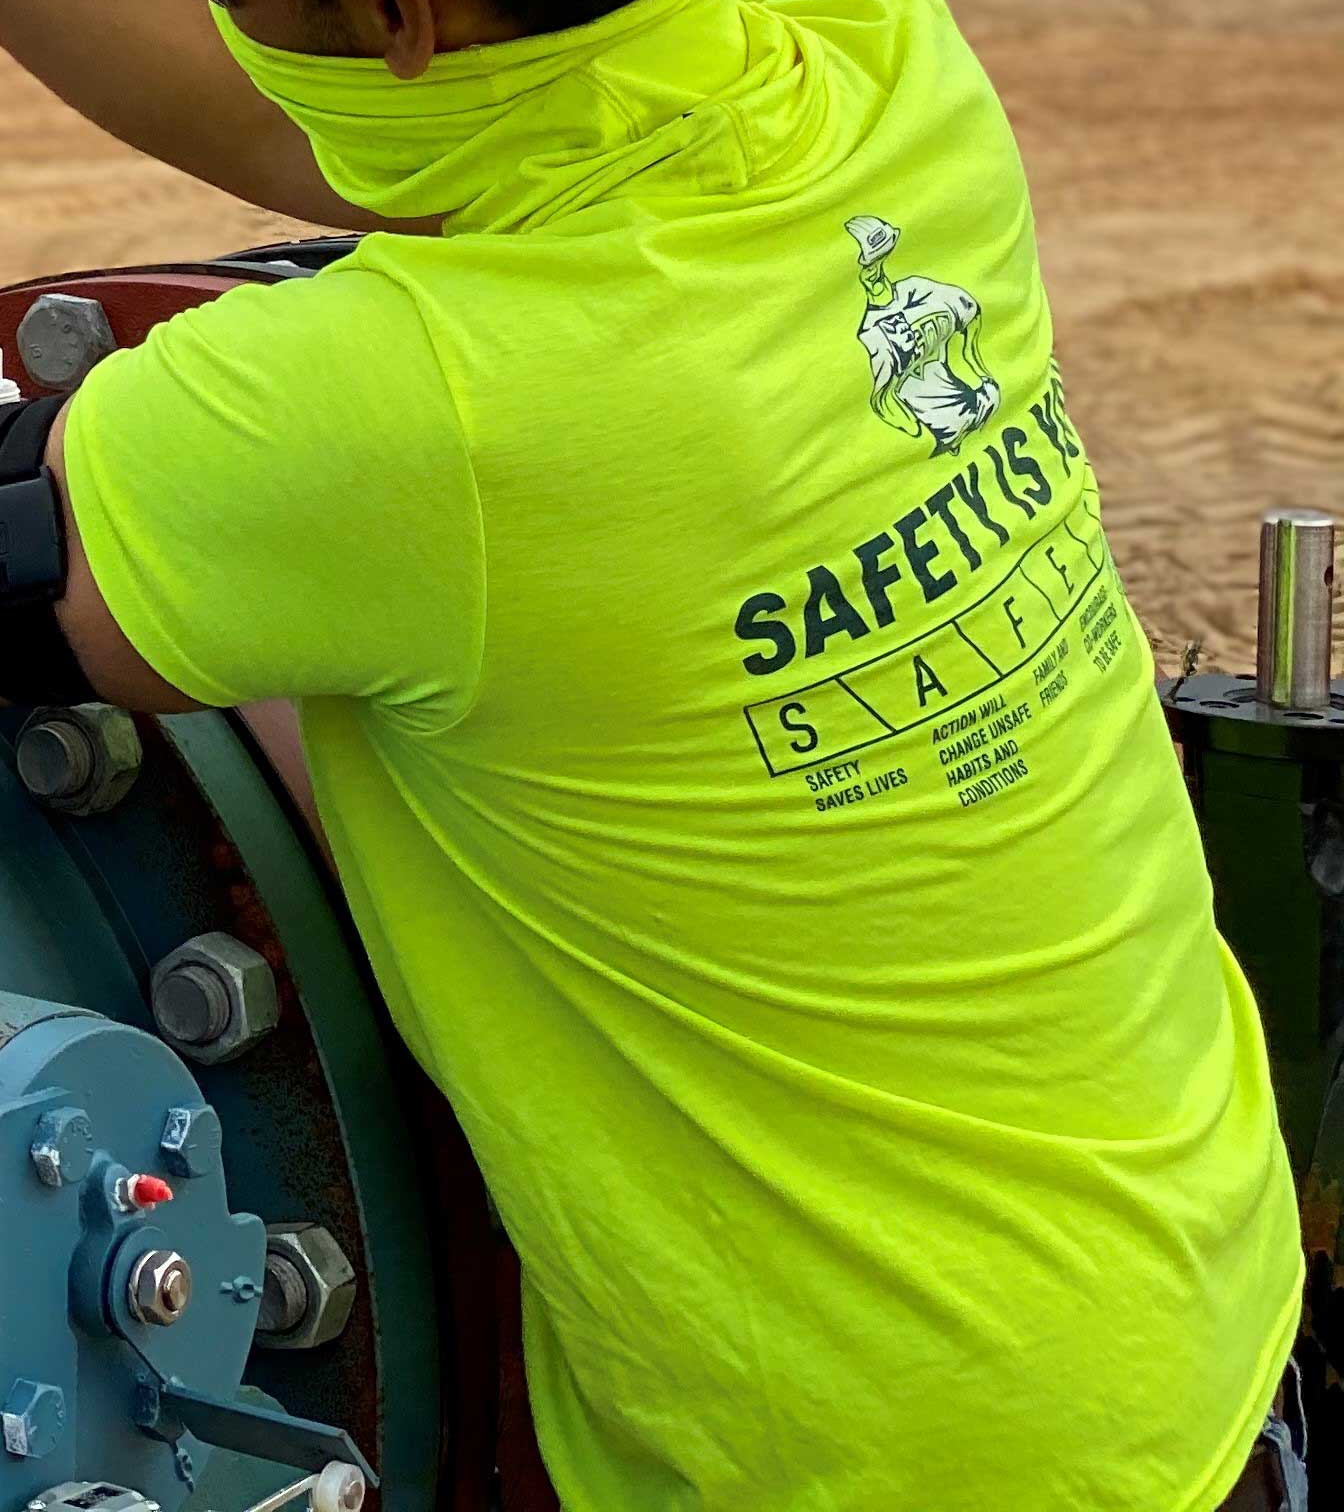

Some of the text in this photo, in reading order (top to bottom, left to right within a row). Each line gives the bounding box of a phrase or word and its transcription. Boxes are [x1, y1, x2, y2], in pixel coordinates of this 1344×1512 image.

[734, 461, 1010, 676] SAFETY
[983, 426, 1052, 519] IS
[778, 546, 1075, 753] S A F E
[1032, 650, 1058, 686] FAMILY
[1040, 669, 1068, 708] FRIENDS
[932, 693, 1008, 745] ACTION WILL
[939, 702, 1032, 766] CHANGE UNSAFE
[805, 759, 862, 793] SAFETY
[945, 739, 1019, 788] HABITS AND
[958, 758, 1030, 808] CONDITIONS
[815, 767, 909, 813] SAVES LIVES
